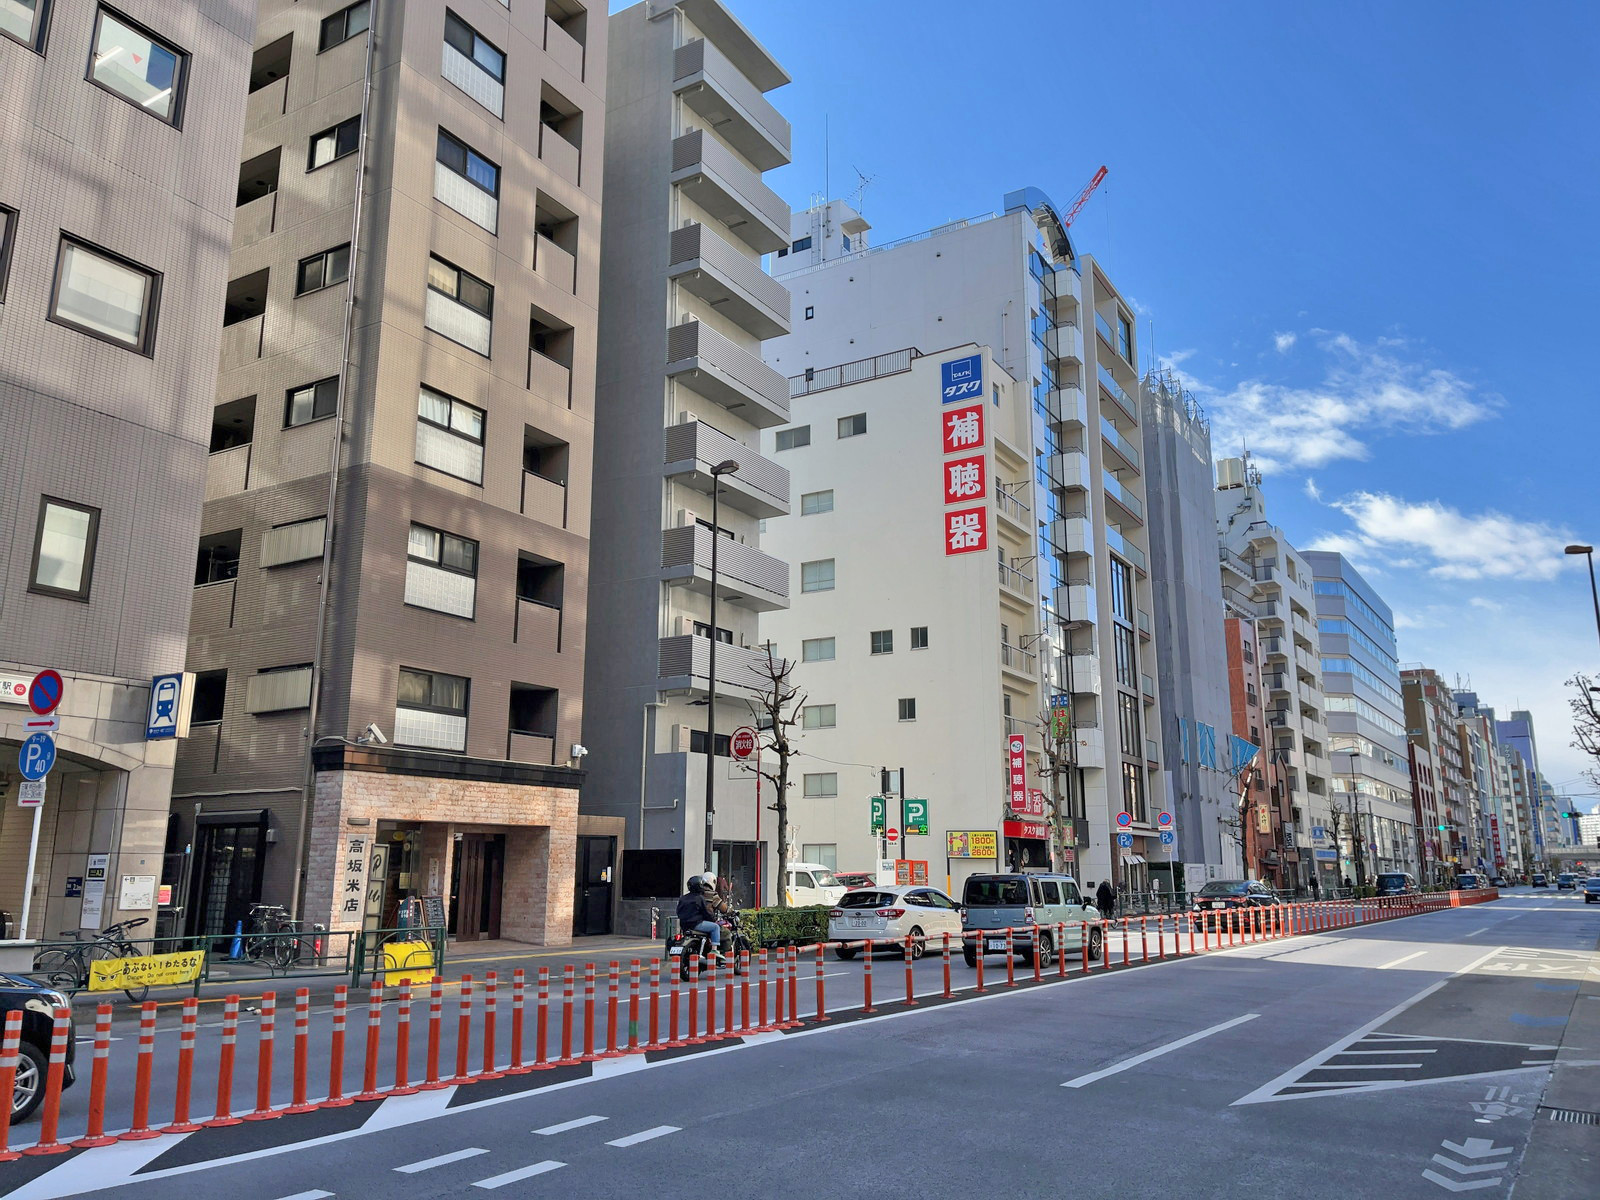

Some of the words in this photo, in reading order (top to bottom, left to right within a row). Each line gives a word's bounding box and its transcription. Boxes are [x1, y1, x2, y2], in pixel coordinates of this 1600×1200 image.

[944, 380, 980, 397] タスク
[947, 411, 982, 549] 補聴器
[735, 739, 753, 750] 消火栓
[25, 744, 41, 773] P
[35, 759, 46, 773] 40
[1012, 757, 1024, 802] 補聴器
[908, 803, 924, 823] P
[344, 840, 364, 912] 高坂米店
